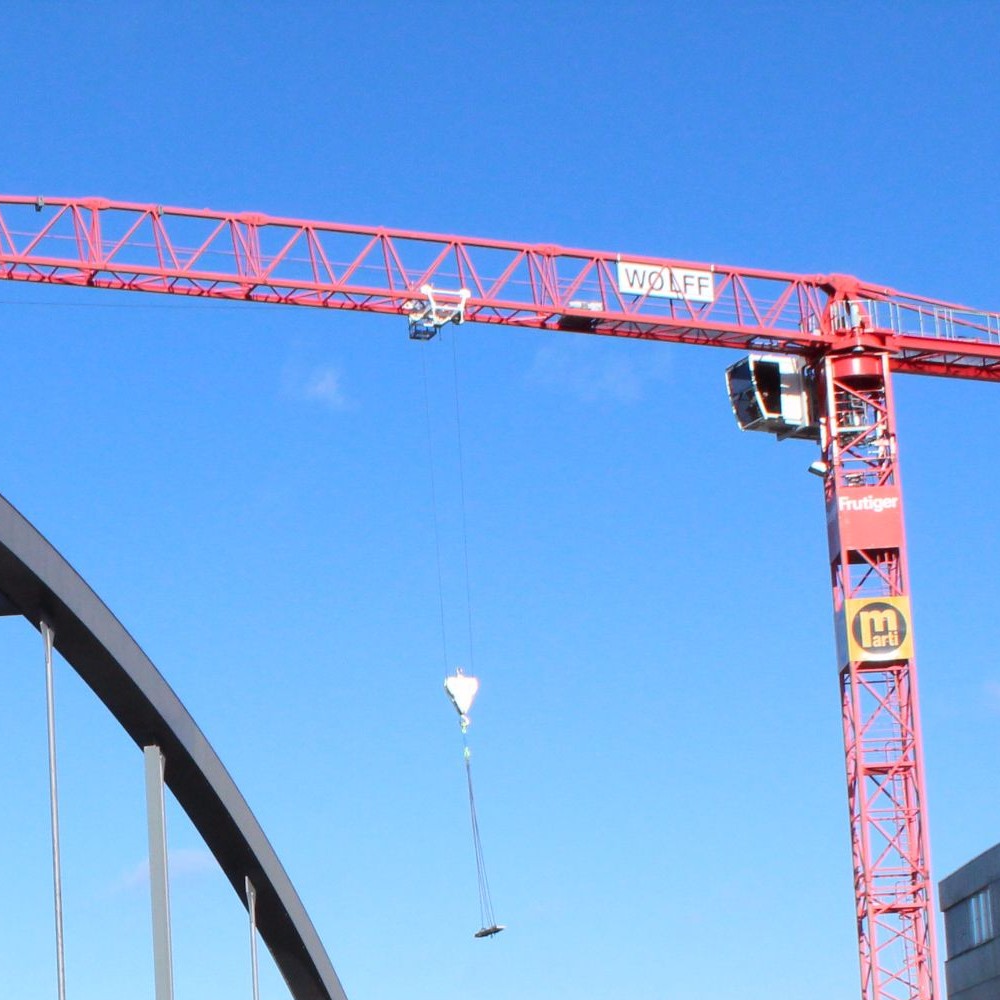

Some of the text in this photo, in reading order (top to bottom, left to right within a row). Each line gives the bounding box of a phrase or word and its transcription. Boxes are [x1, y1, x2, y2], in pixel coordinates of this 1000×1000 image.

[624, 267, 709, 296] WOLFF
[838, 495, 899, 512] Frutiger
[859, 608, 899, 648] marti
